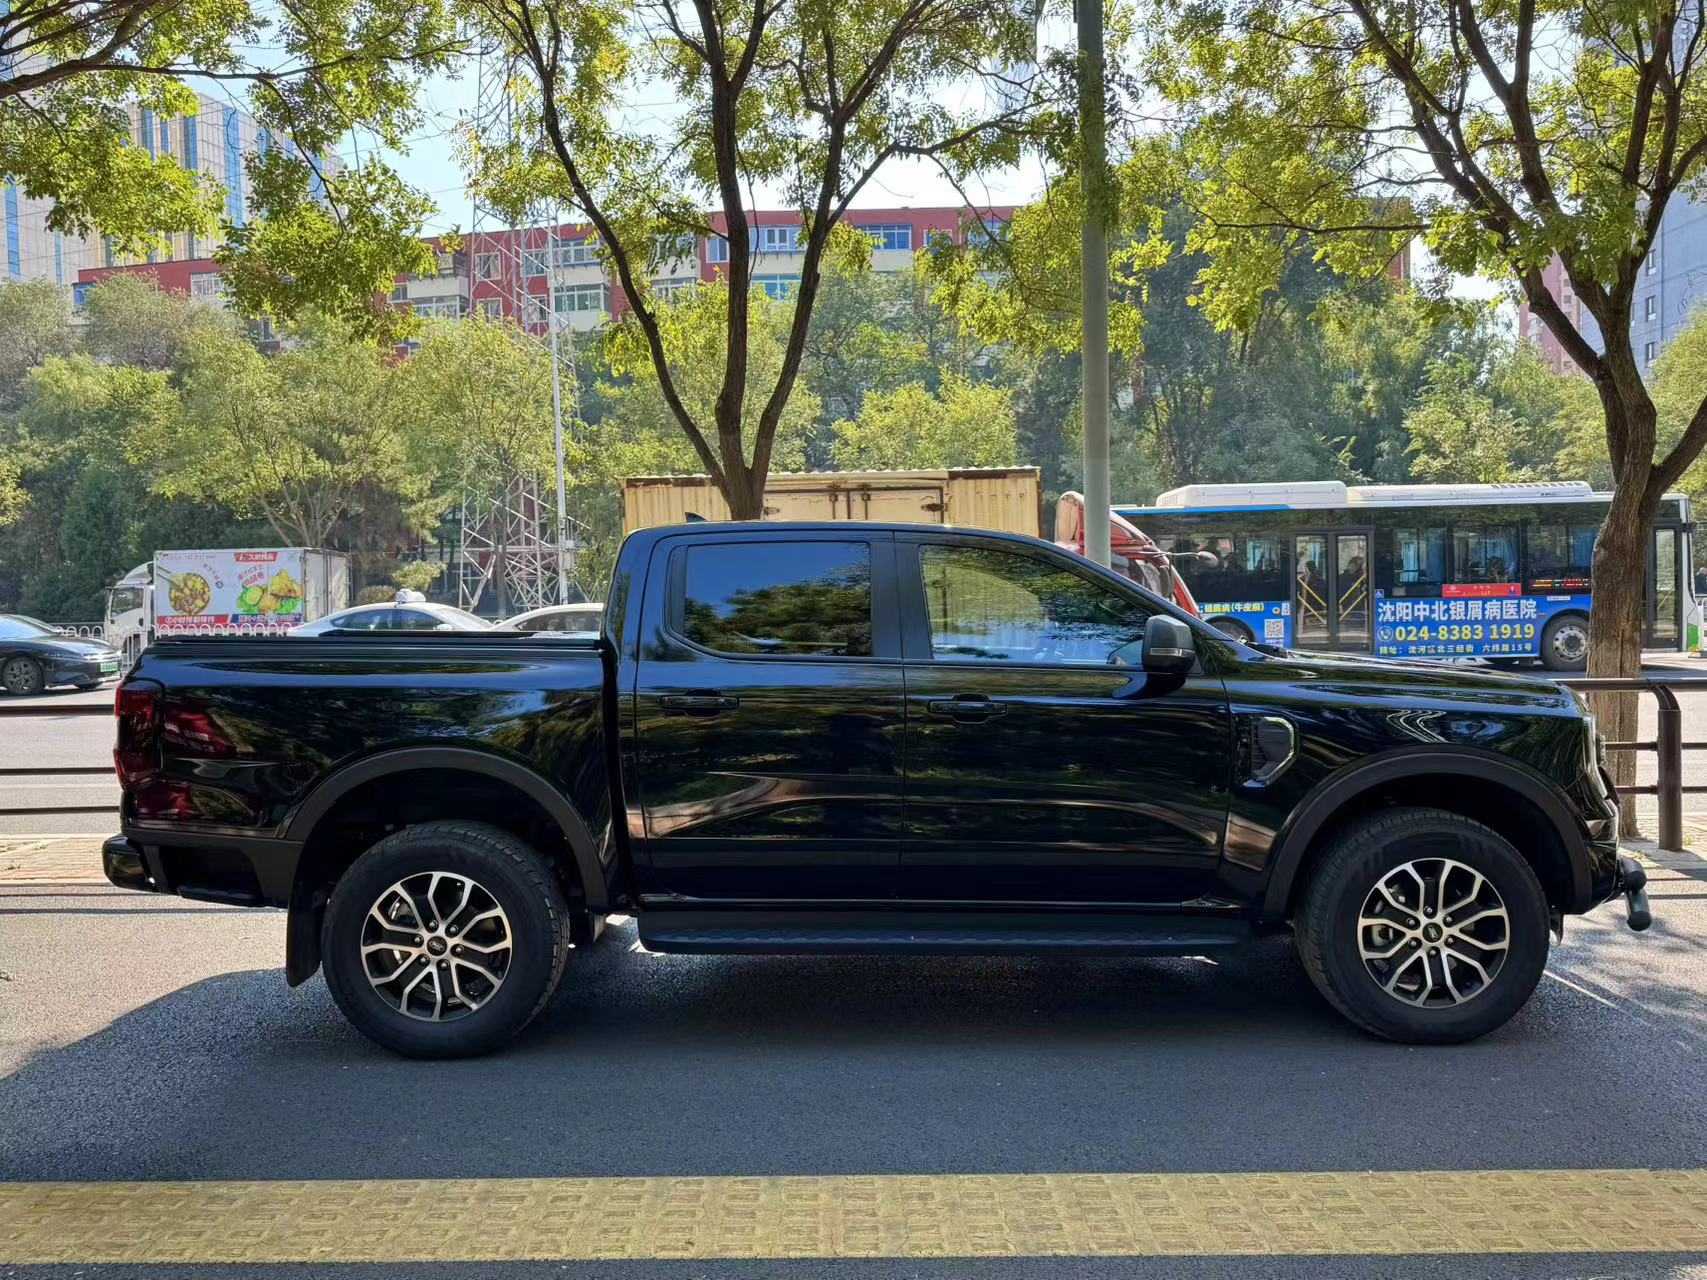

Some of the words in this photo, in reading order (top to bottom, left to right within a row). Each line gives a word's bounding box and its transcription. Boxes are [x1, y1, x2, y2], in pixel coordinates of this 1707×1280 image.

[1378, 599, 1537, 622] 沈阳中北银屑病医院
[1395, 625, 1483, 641] 024-8383
[1490, 624, 1536, 640] 1919
